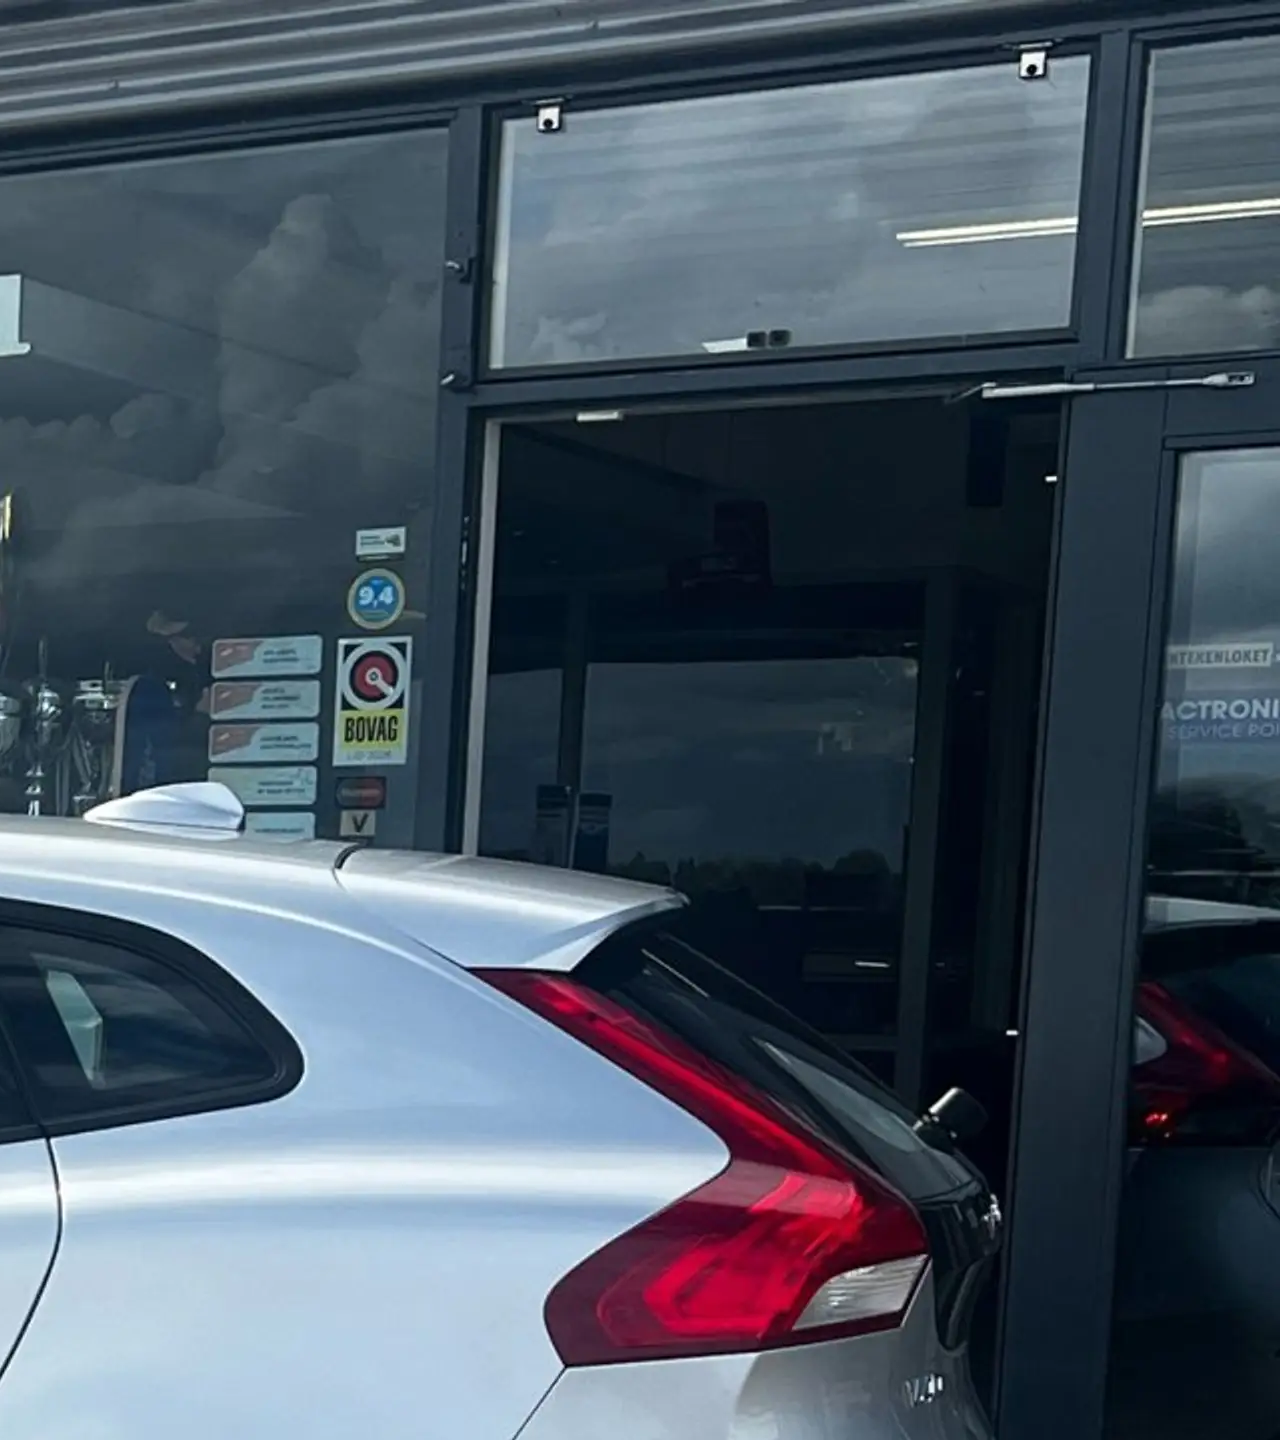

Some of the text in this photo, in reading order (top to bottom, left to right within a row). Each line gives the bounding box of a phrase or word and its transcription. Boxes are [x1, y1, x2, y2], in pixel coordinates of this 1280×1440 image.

[358, 585, 394, 608] 9,4
[344, 716, 398, 743] BOVAG
[1168, 723, 1242, 739] SERVICE
